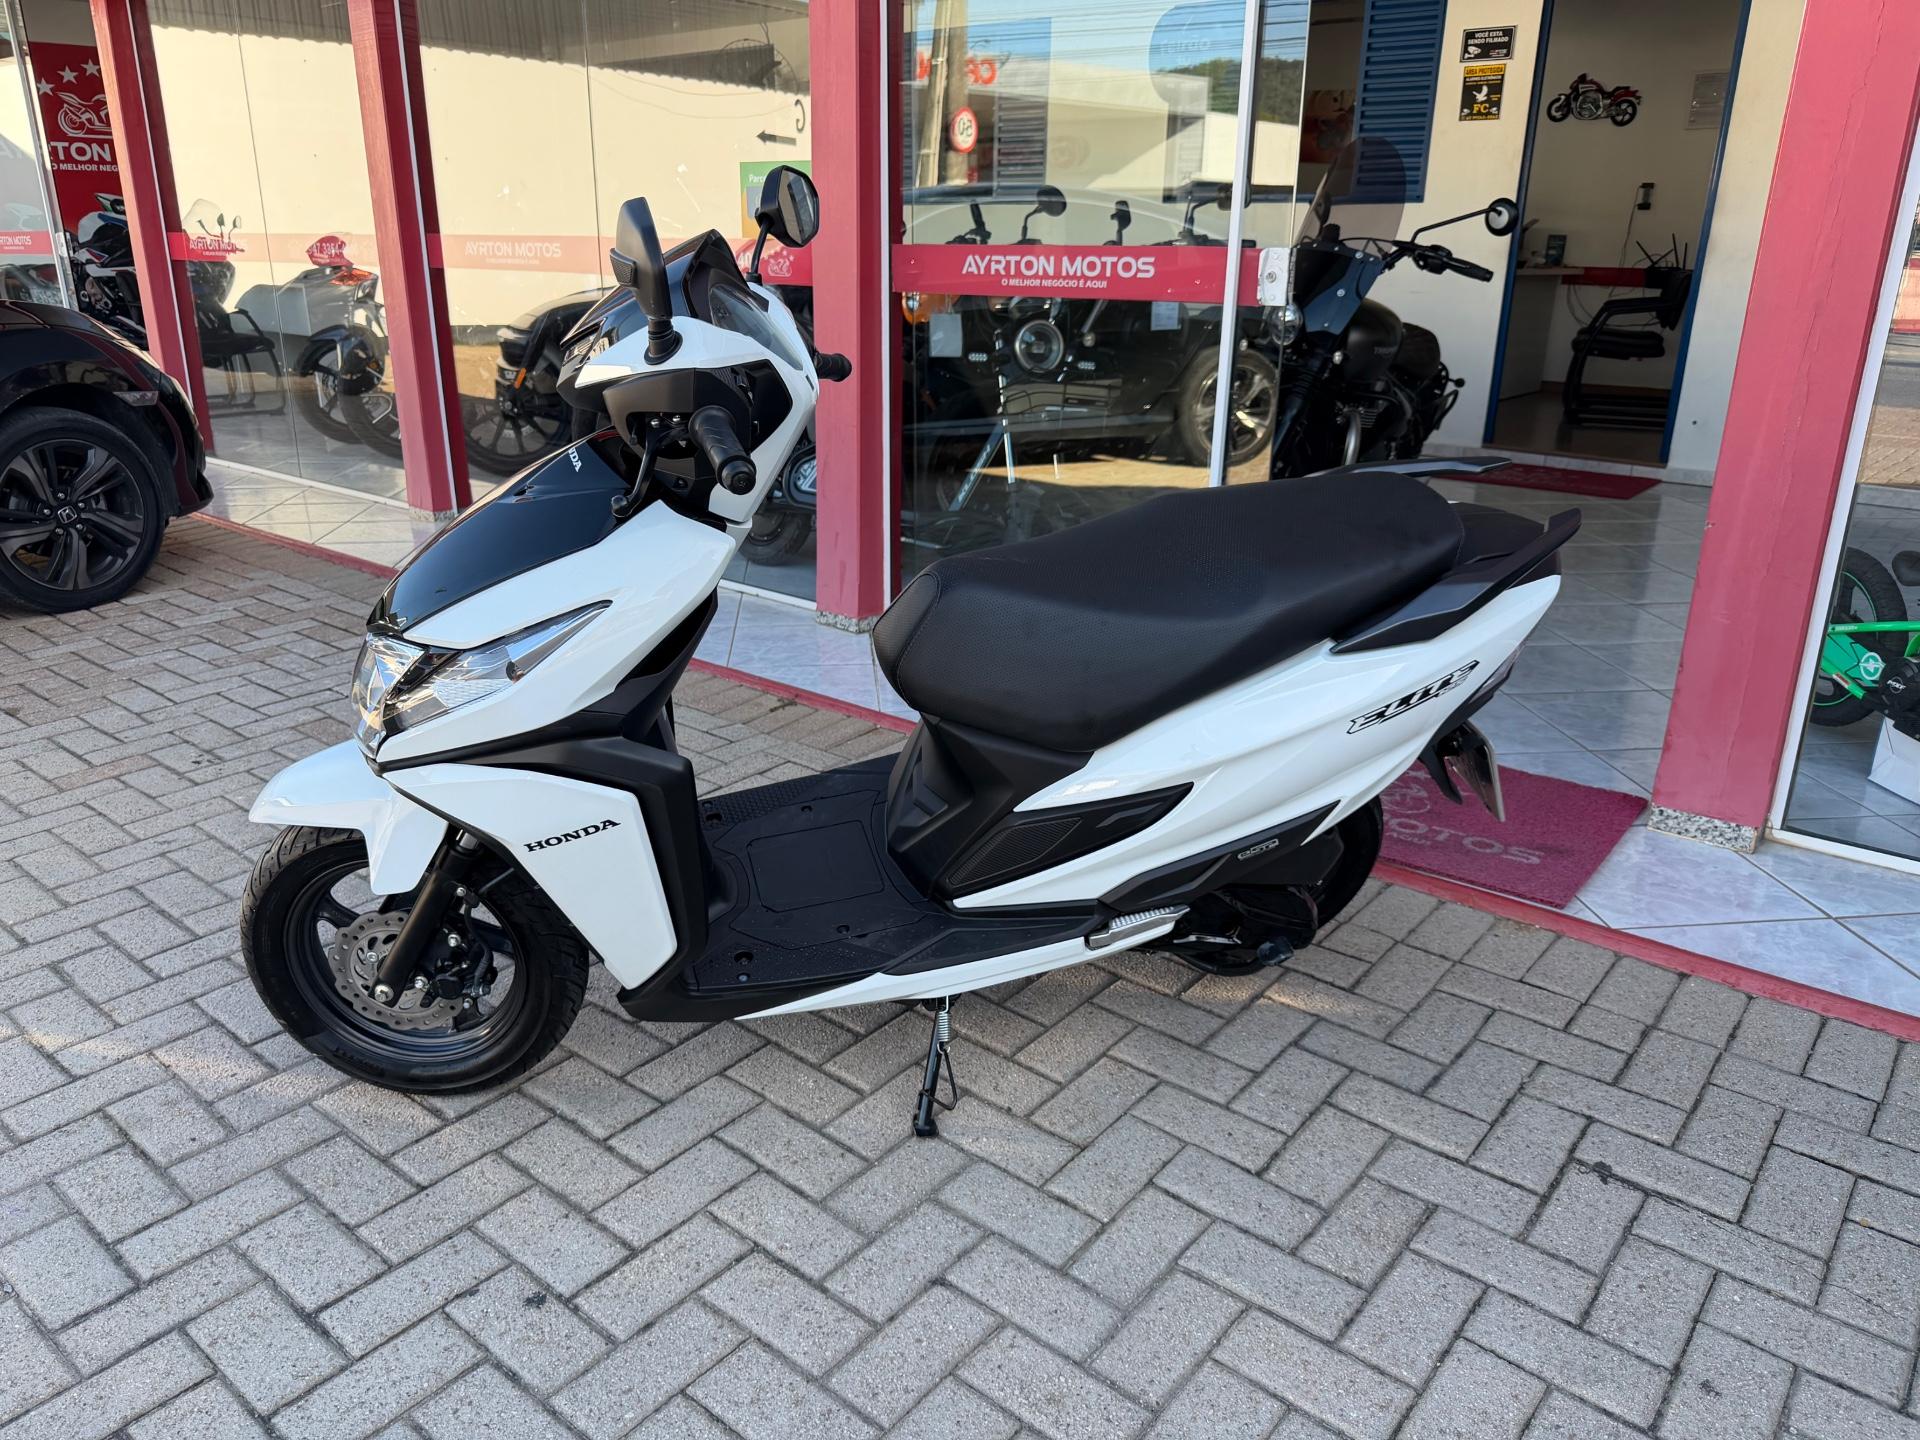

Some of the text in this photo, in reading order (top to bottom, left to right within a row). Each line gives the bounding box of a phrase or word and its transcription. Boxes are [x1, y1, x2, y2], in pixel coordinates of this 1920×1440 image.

[49, 141, 112, 161] TON
[60, 163, 98, 172] MELHOR
[99, 164, 118, 172] NEG
[465, 240, 562, 257] AYRTON MOTOS
[962, 254, 1156, 279] AYRTON MOTOS
[1008, 279, 1041, 287] MELHOR
[1041, 278, 1077, 288] NEGÓCIO
[1078, 278, 1085, 288] É
[1085, 280, 1108, 288] AQUI
[523, 819, 622, 852] HONDA
[1385, 814, 1546, 866] OTOS
